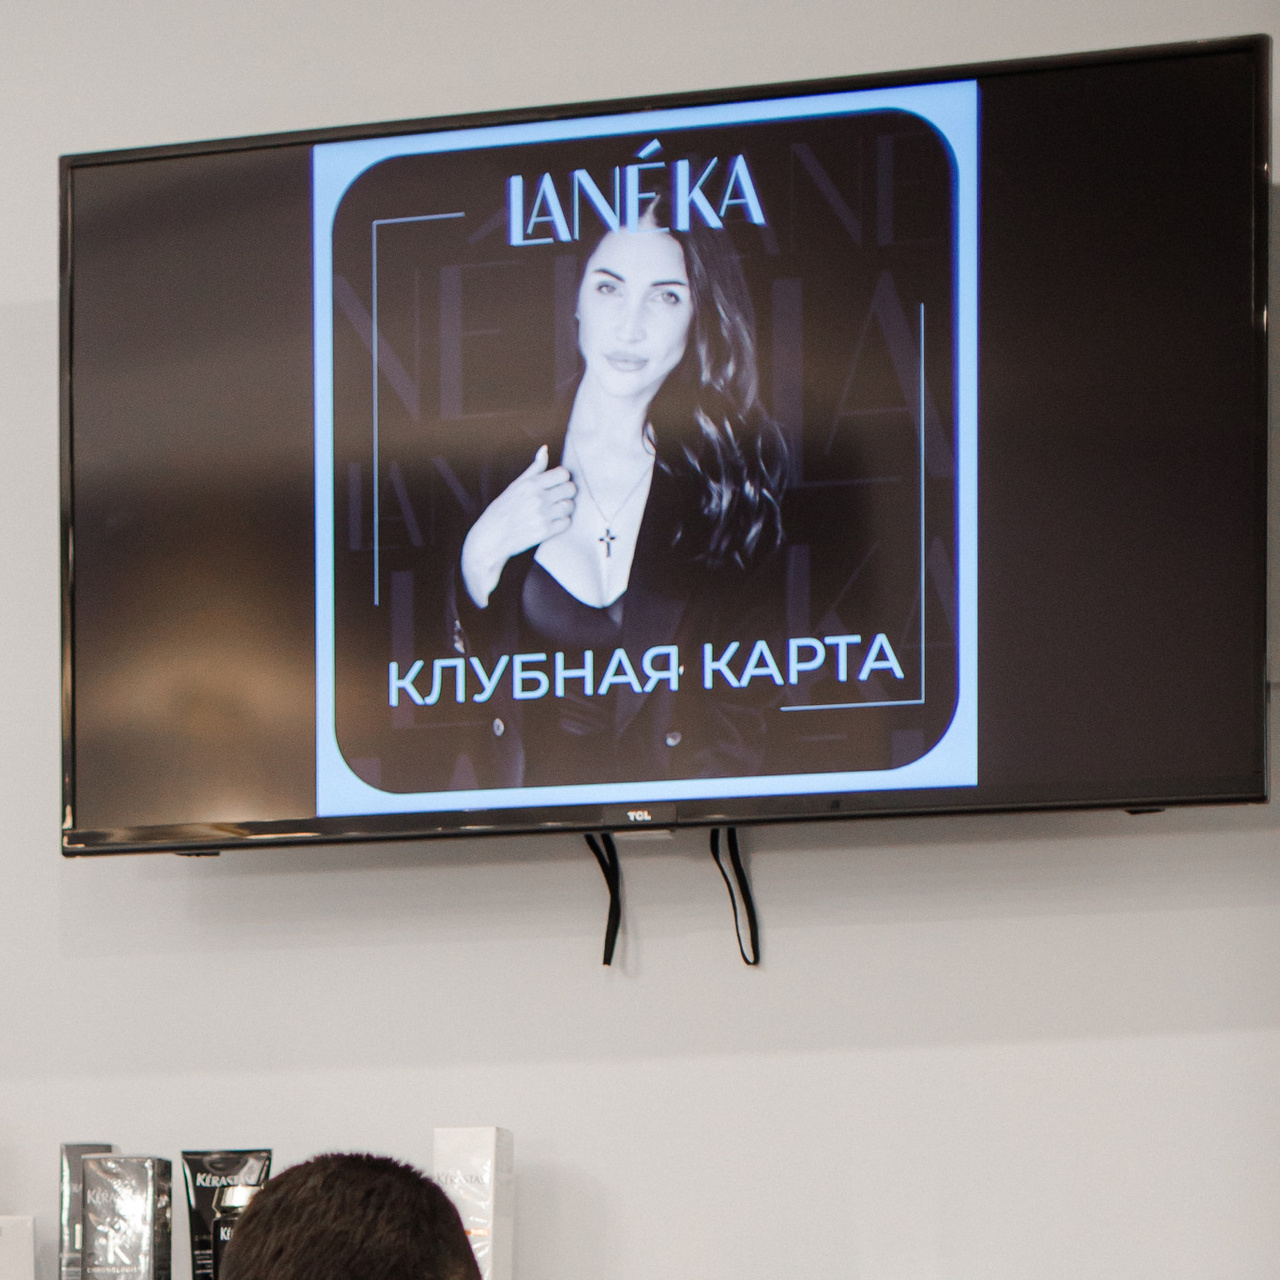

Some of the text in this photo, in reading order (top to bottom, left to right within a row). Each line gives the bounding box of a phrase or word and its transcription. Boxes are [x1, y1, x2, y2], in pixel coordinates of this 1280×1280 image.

[509, 138, 768, 247] LANÉKA
[387, 632, 905, 707] КЛУБНАЯ КАРТА
[626, 809, 652, 822] TCL
